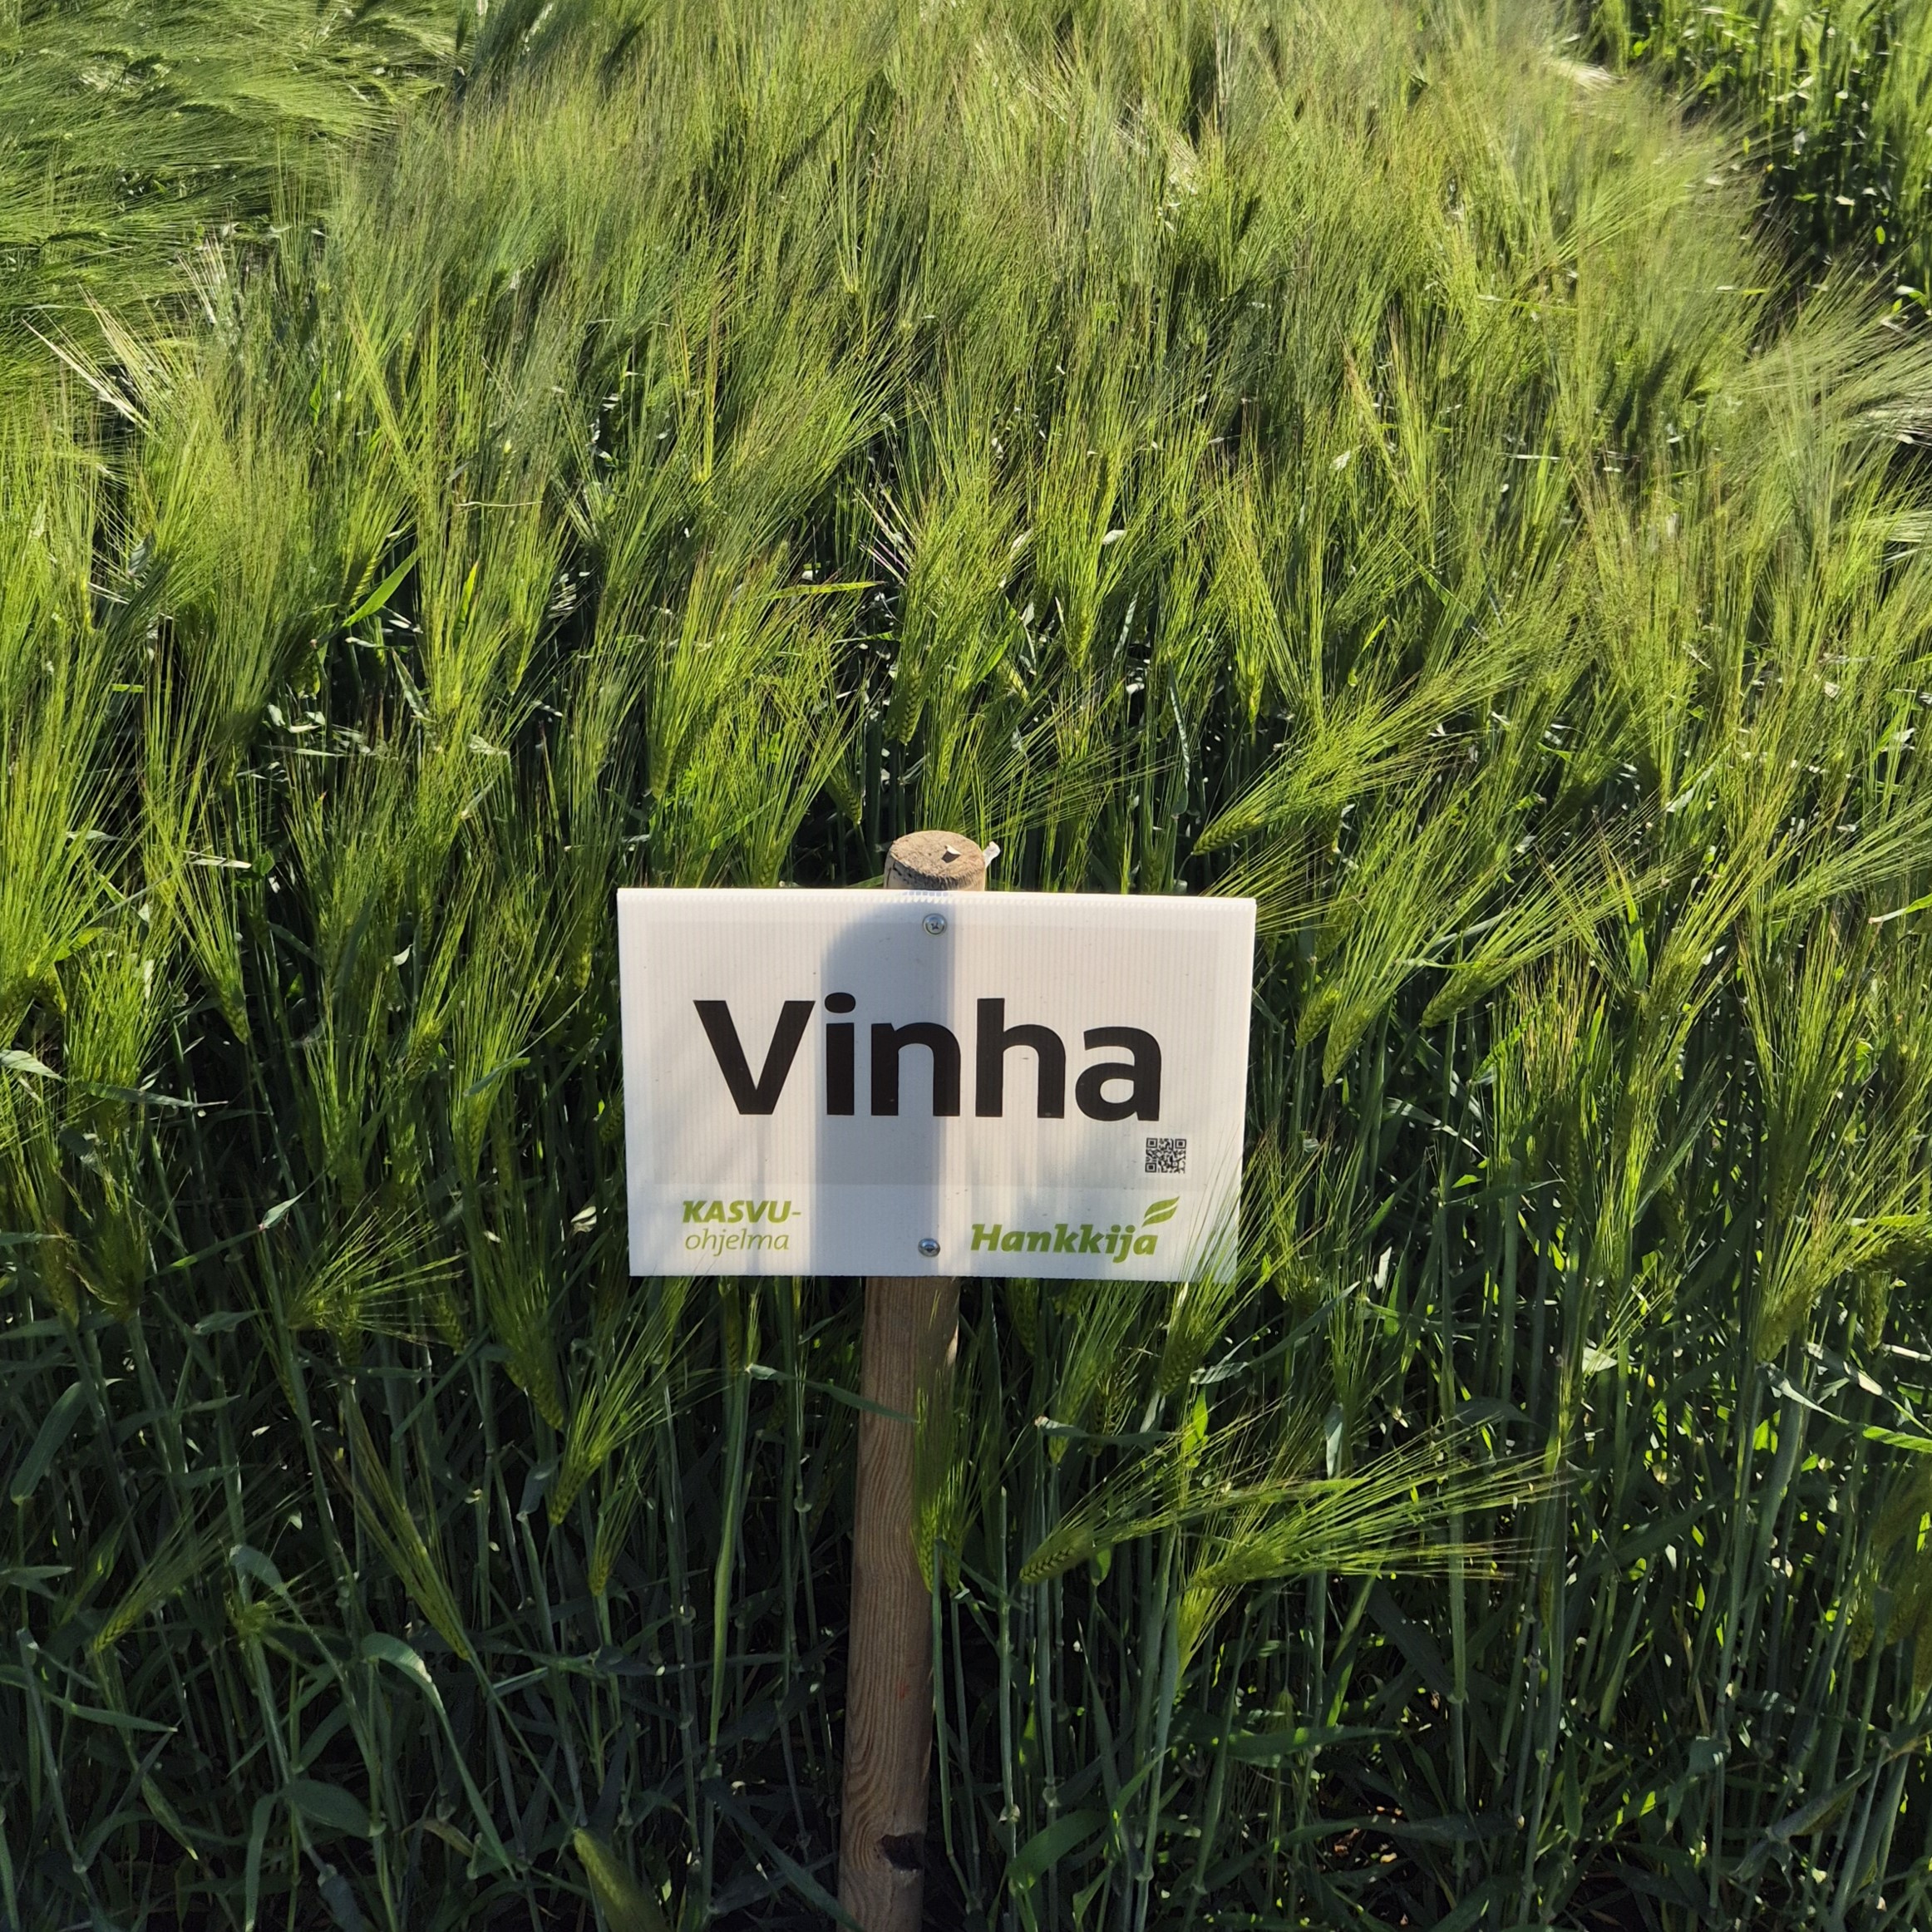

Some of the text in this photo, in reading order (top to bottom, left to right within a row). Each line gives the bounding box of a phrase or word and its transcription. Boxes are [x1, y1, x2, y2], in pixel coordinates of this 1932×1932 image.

[693, 992, 1162, 1121] Vinha
[682, 1200, 801, 1224] KASVU-
[684, 1228, 790, 1257] ohjelma
[970, 1223, 1158, 1264] Hankkija
